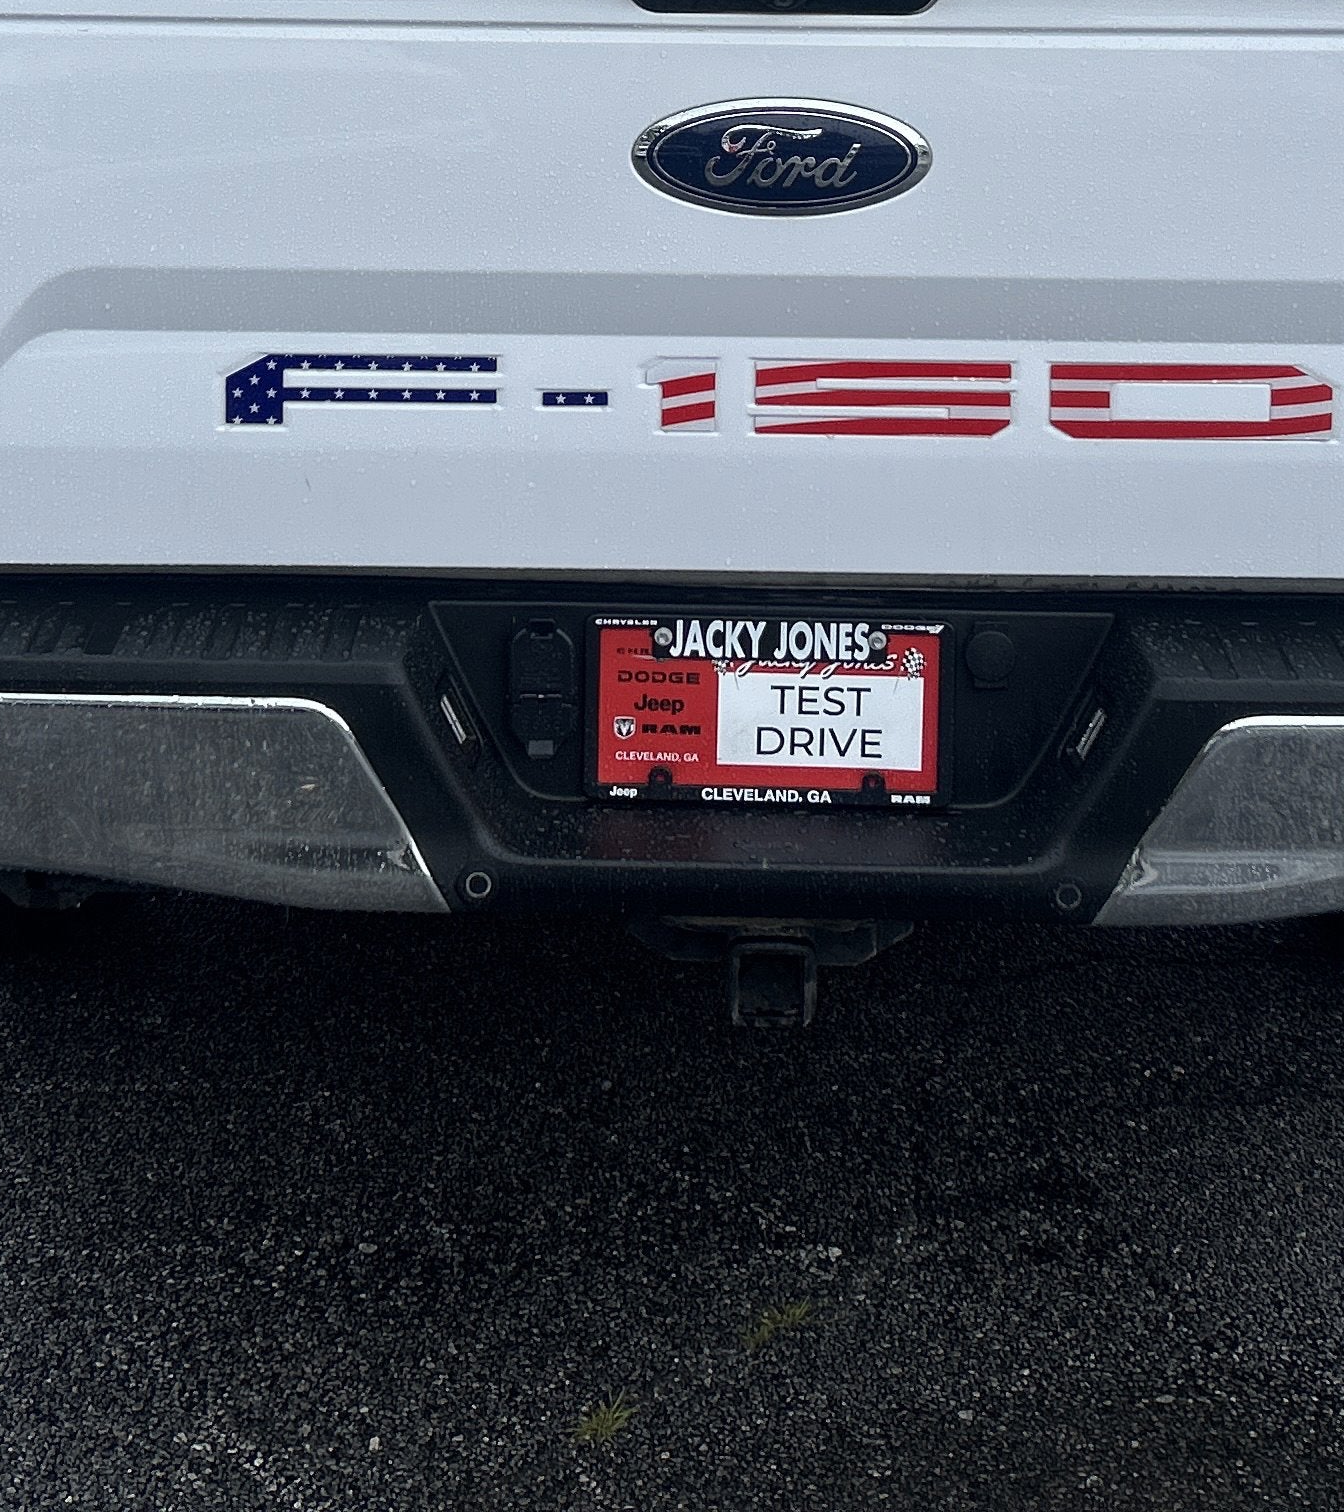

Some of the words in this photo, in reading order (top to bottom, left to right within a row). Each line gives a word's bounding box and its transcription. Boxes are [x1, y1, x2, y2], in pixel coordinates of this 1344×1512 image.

[704, 124, 861, 189] Ford
[224, 352, 1334, 441] F-150
[668, 619, 767, 658] JACKY
[773, 620, 870, 661] JONES
[617, 670, 701, 685] DODGE
[633, 693, 685, 715] Jeep
[770, 684, 872, 717] TEST
[641, 723, 702, 736] RAM
[755, 726, 883, 759] DRIVE
[615, 750, 682, 763] CLEVELAND,
[683, 752, 700, 763] GA
[609, 786, 639, 799] Jeep
[806, 789, 833, 804] GA
[890, 794, 931, 804] RAM
